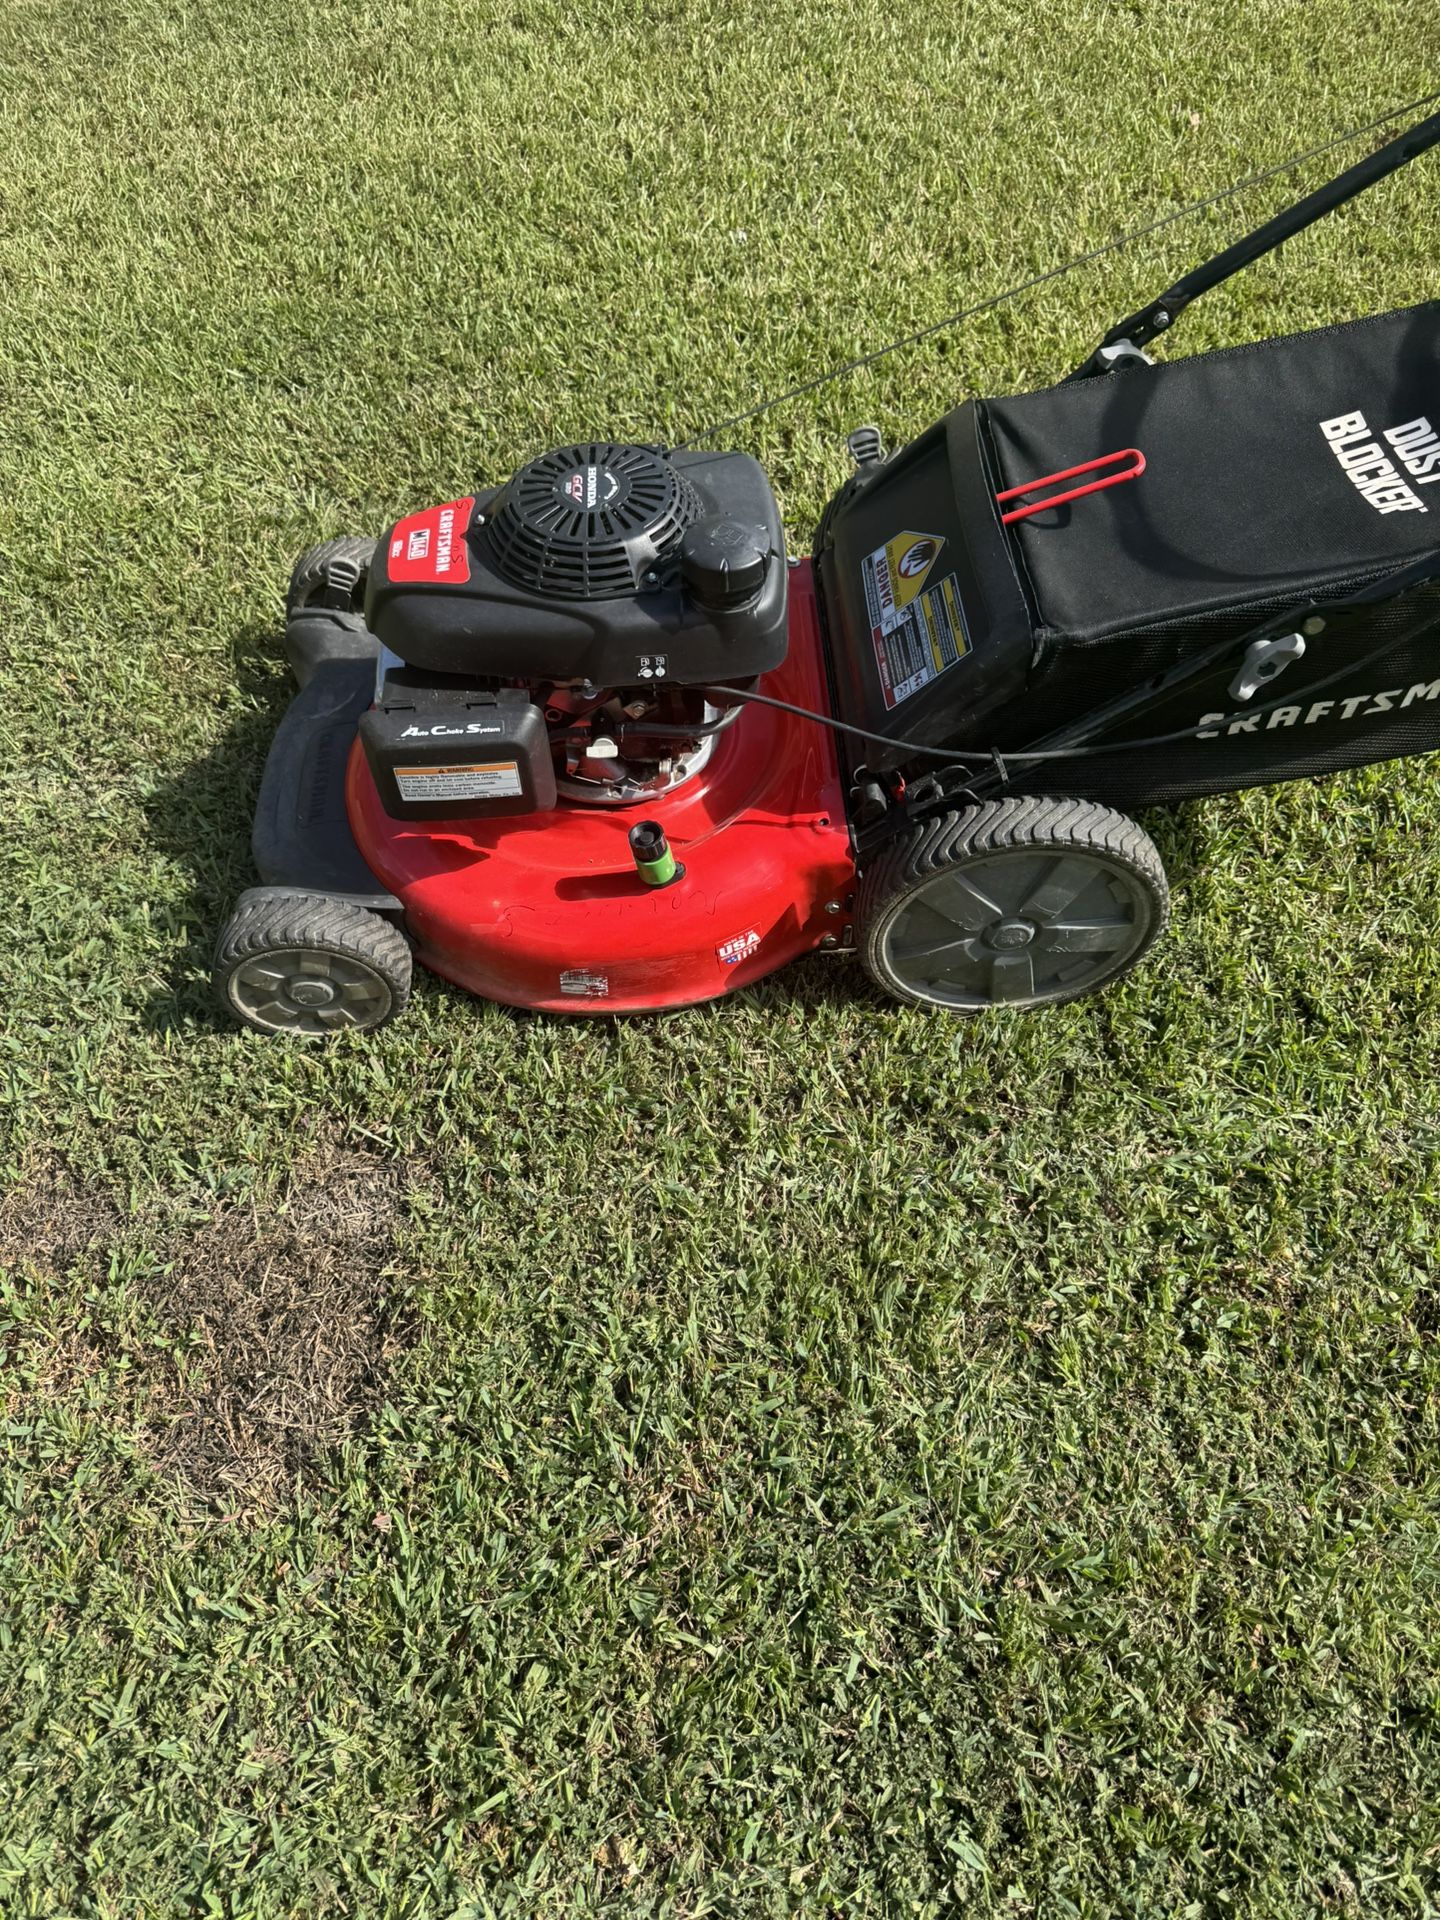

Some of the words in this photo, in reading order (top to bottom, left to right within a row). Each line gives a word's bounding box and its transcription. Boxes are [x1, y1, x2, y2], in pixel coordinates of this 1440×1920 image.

[1319, 410, 1428, 515] BLOCKER
[572, 474, 583, 503] GCV
[587, 467, 597, 509] HONDA
[435, 509, 454, 572] CRAFTSMAN
[876, 556, 893, 609] DANGER
[400, 725, 429, 737] Auto
[431, 725, 464, 736] Choke
[466, 723, 501, 735] System
[719, 932, 761, 957] USA
